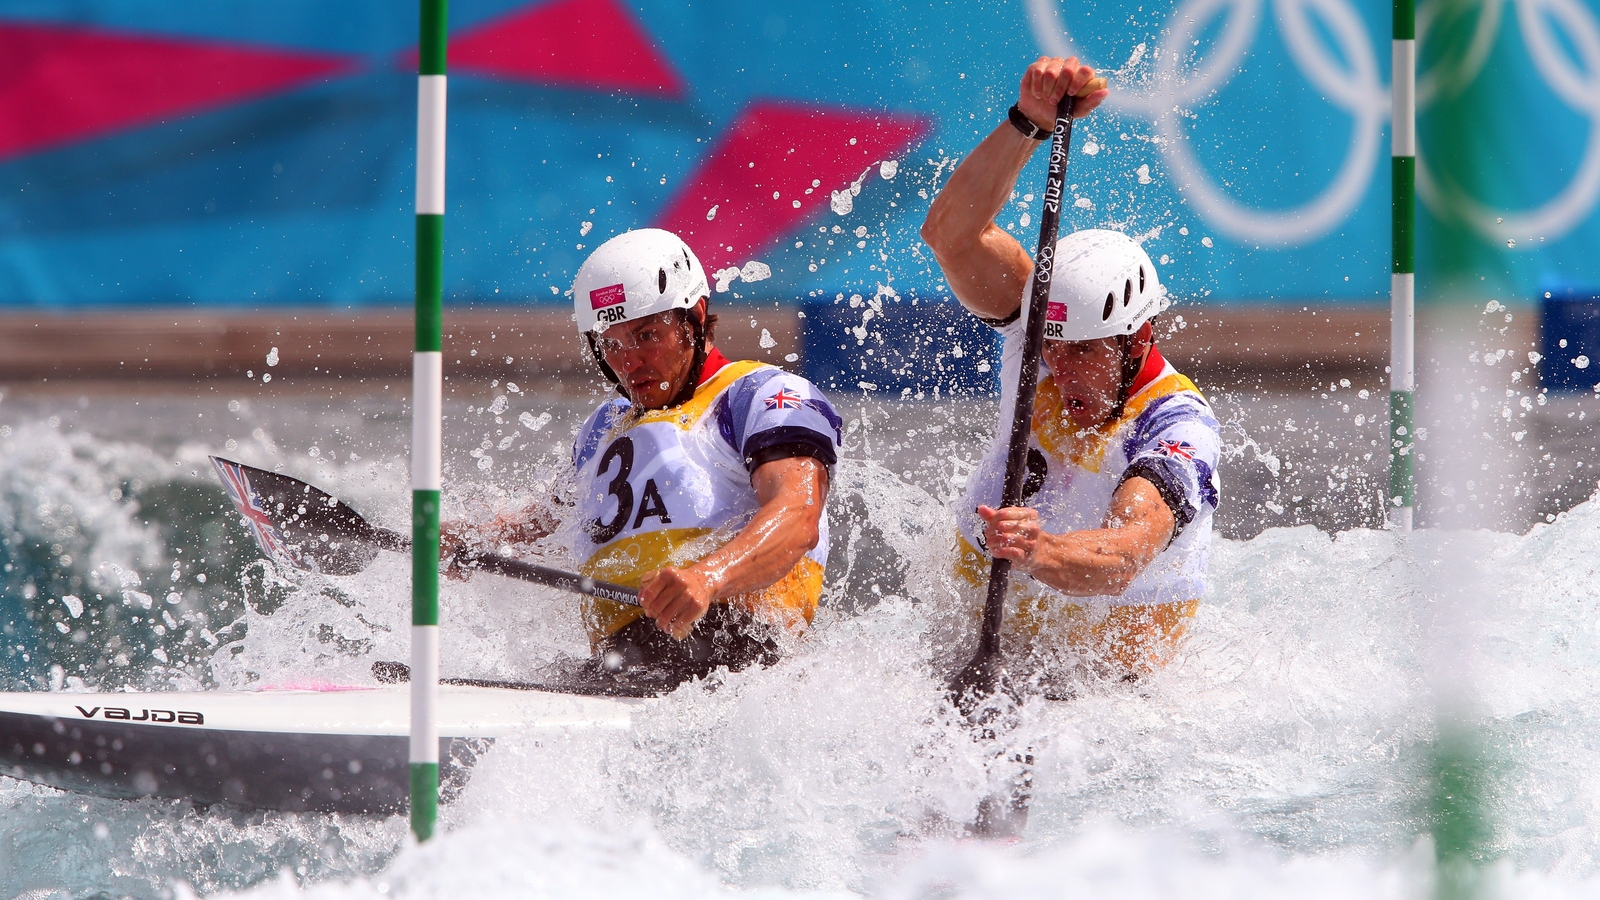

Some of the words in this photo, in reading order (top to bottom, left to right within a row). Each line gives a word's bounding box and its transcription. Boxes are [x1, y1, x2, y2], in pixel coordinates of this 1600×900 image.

[1049, 117, 1069, 174] London
[1044, 179, 1062, 213] 2012
[597, 305, 627, 323] GBR
[1132, 299, 1154, 322] PREDATOR
[1043, 322, 1064, 338] BR
[612, 590, 639, 606] ondon
